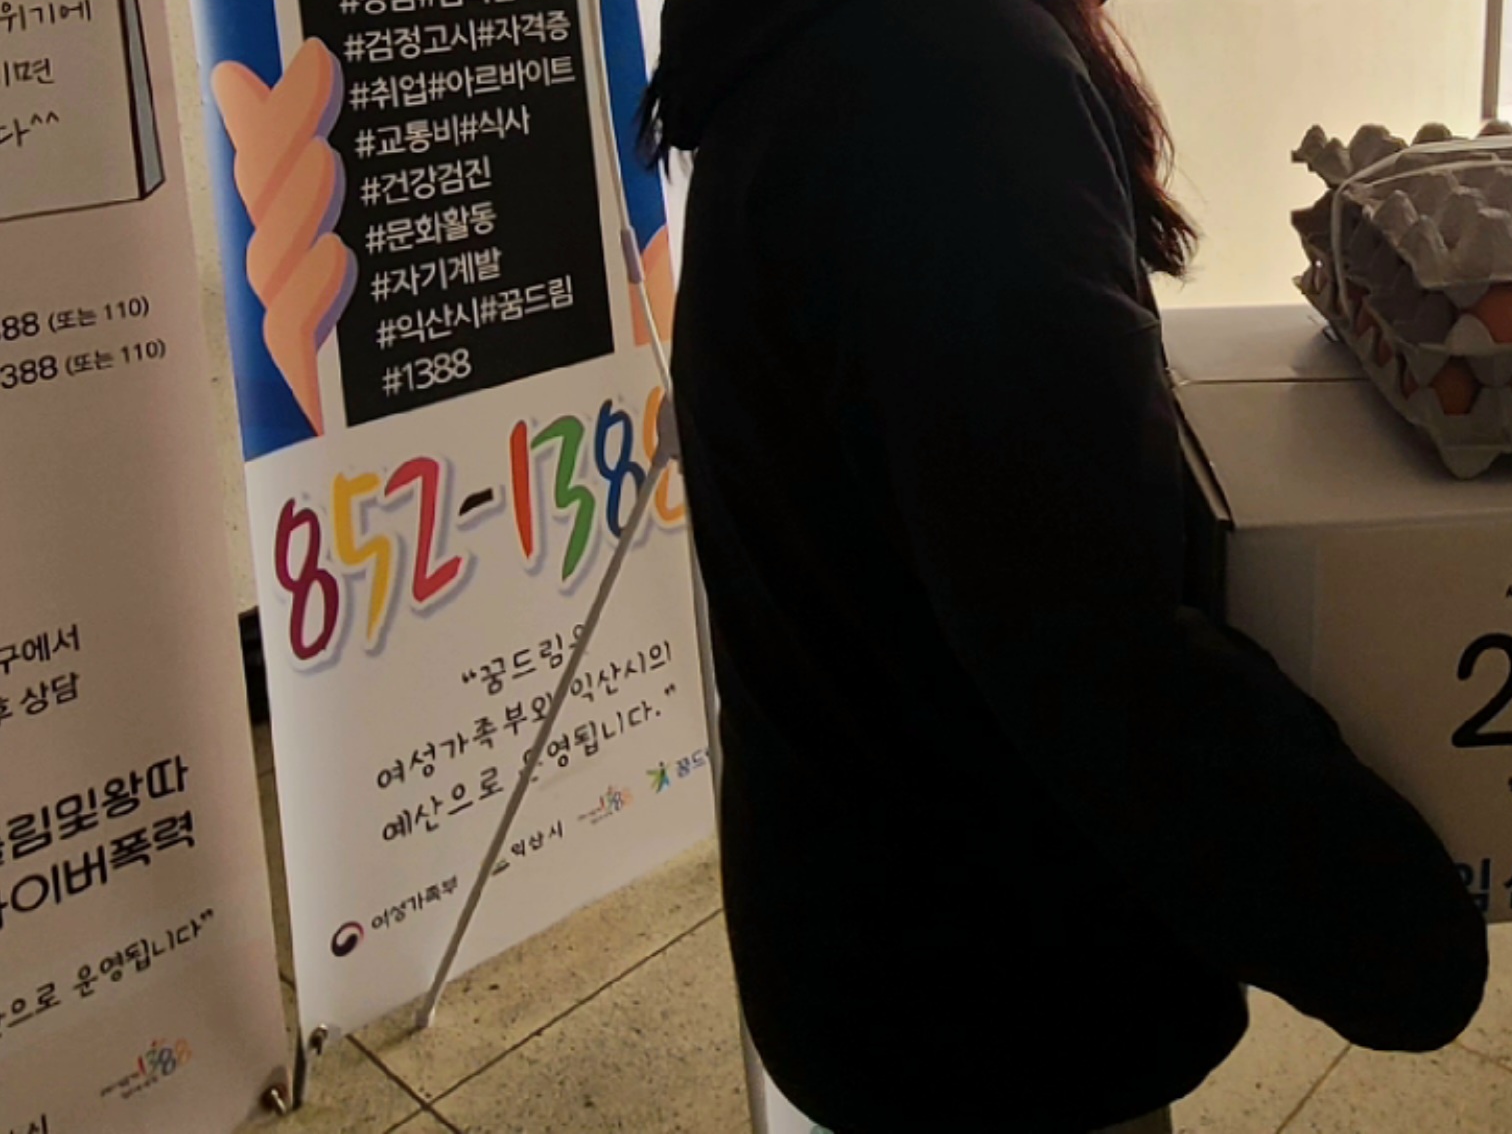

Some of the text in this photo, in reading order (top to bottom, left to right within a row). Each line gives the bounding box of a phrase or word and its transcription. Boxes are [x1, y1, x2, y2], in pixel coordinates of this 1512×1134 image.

[344, 10, 571, 63] #검정고시#자격증
[349, 56, 575, 111] #취업#아르바이트
[355, 104, 530, 159] #교통비#식사
[360, 155, 492, 206] #건강검진
[365, 201, 497, 255] #문화활동
[370, 246, 502, 302] #자기계발
[0, 295, 150, 341] 88 (또는 110)
[376, 274, 574, 349] #익산시#꿈드림
[65, 350, 113, 377] (또는
[121, 338, 166, 364] 110)
[382, 347, 472, 397] #1388
[20, 672, 80, 715] 상담
[569, 640, 672, 702] 익산시의
[0, 755, 189, 864] 림및왕따
[382, 766, 504, 842] 예산으로
[0, 982, 61, 1039] 으로
